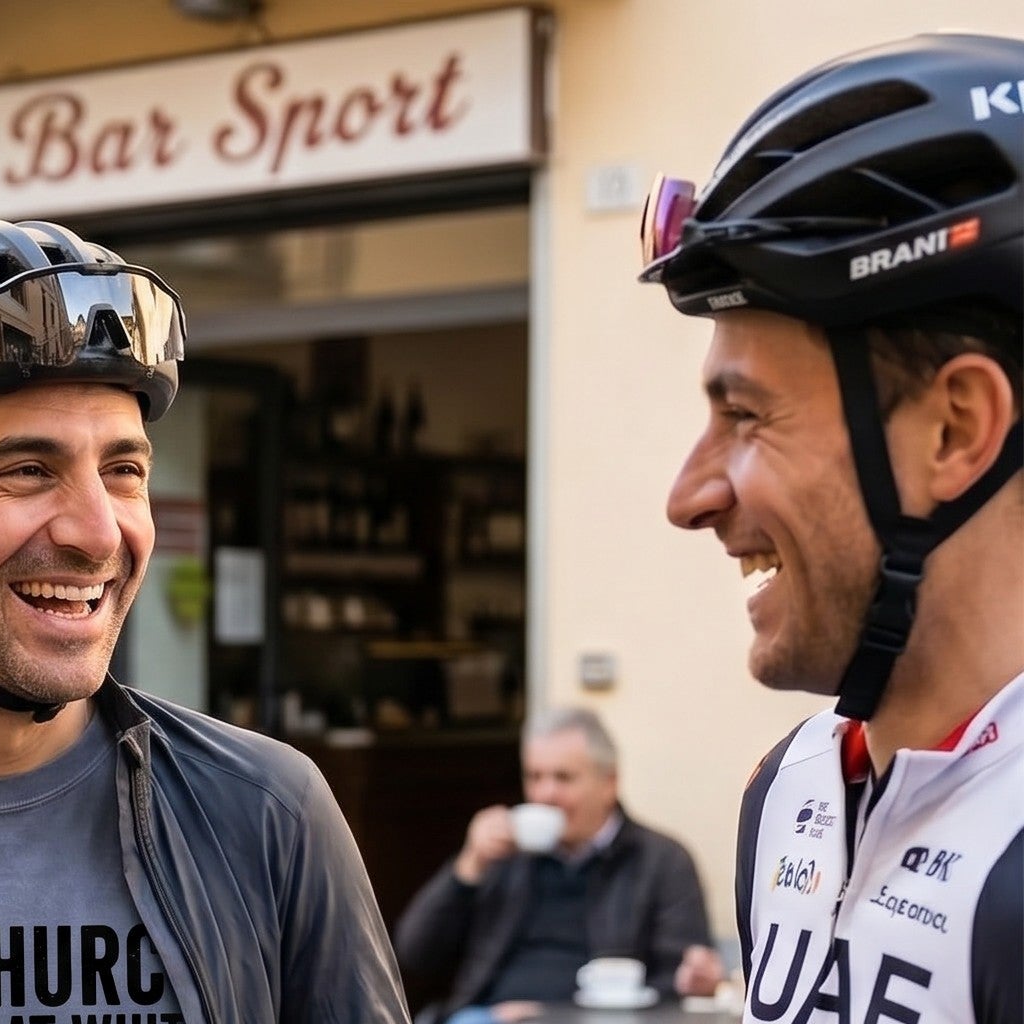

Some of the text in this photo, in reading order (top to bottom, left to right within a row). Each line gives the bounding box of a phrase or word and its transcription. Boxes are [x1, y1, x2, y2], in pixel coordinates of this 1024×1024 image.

[2, 52, 473, 188] Bar Sport
[970, 80, 1024, 120] K
